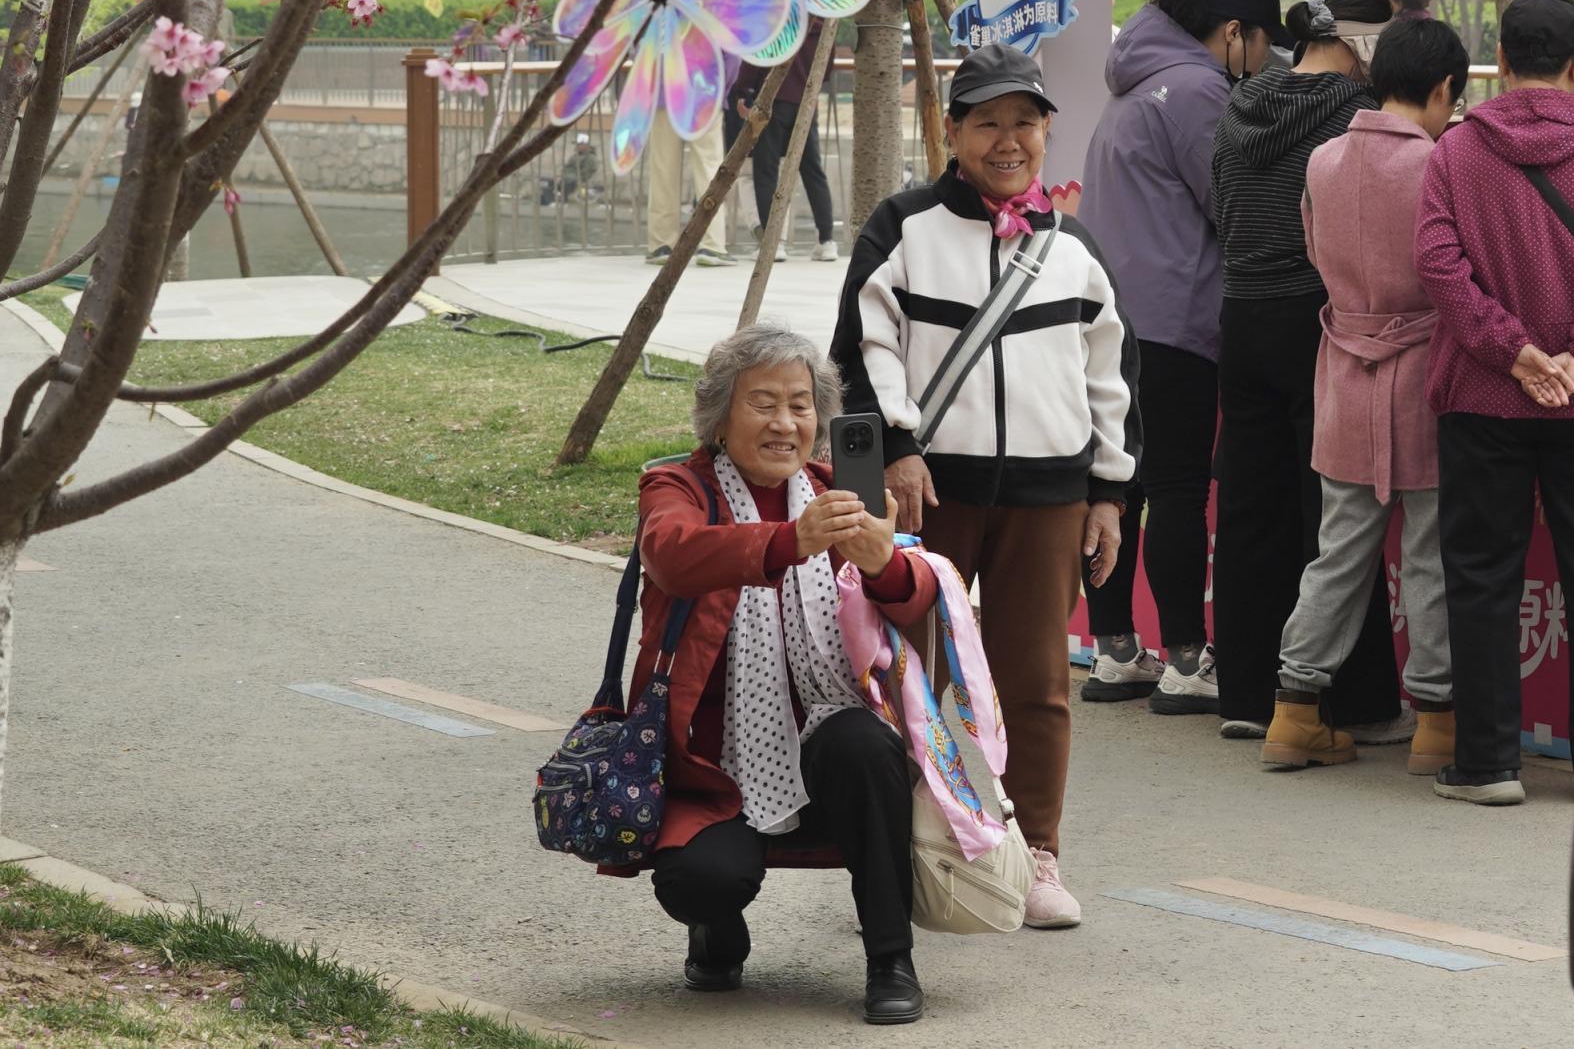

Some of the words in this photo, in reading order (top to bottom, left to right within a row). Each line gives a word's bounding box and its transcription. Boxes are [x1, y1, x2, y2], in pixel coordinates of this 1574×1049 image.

[970, 1, 1059, 47] 雀巢冰淇淋为原料
